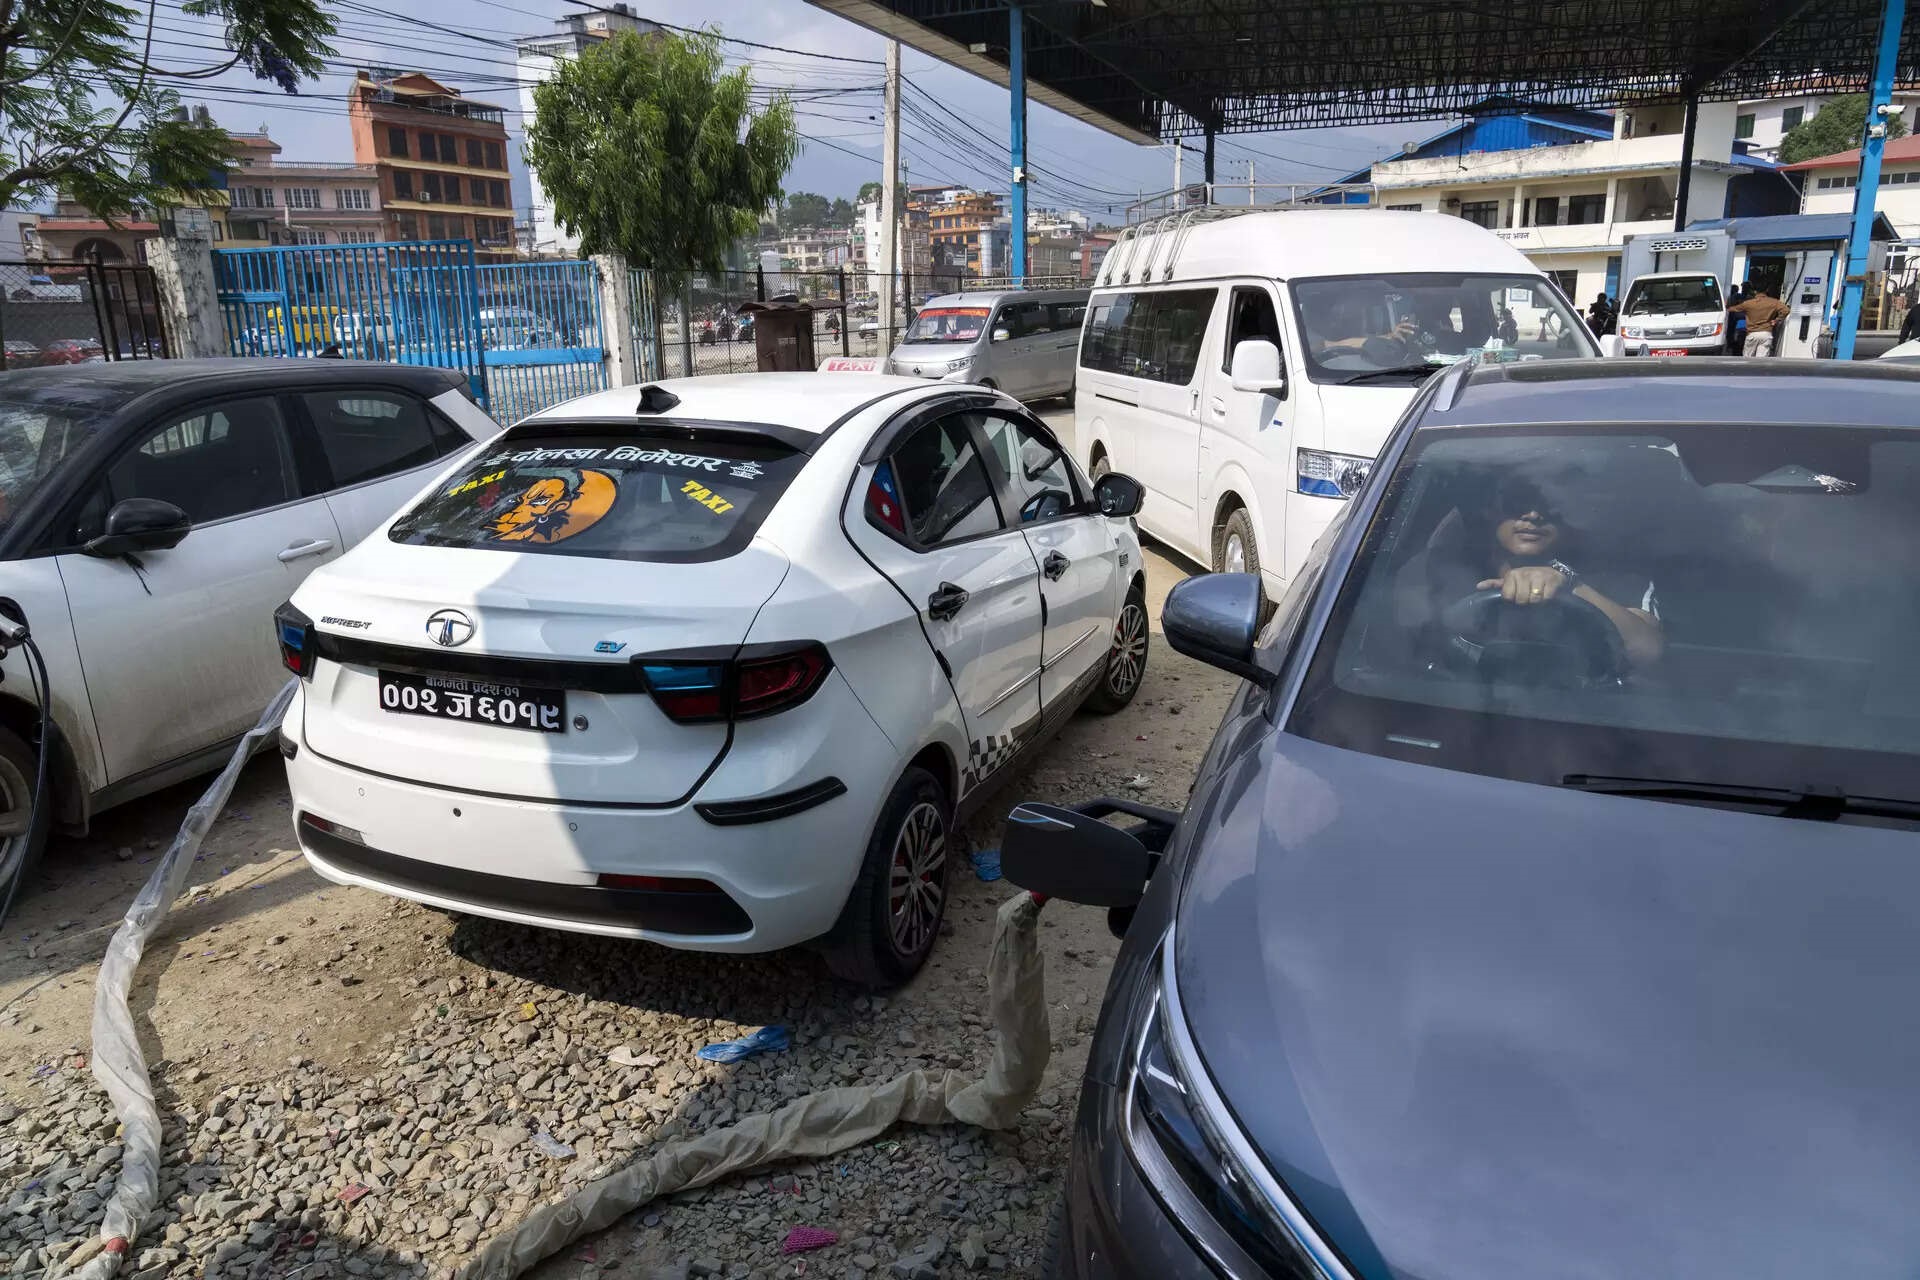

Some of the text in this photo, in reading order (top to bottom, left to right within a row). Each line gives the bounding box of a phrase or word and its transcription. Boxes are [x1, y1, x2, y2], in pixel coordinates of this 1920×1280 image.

[829, 360, 876, 371] TAXI
[510, 446, 731, 471] दोलखा भिमेश्वर
[448, 470, 507, 497] TAXI
[680, 480, 734, 514] TAXI
[594, 640, 627, 653] EV
[383, 684, 438, 713] ००२
[444, 691, 474, 718] ज
